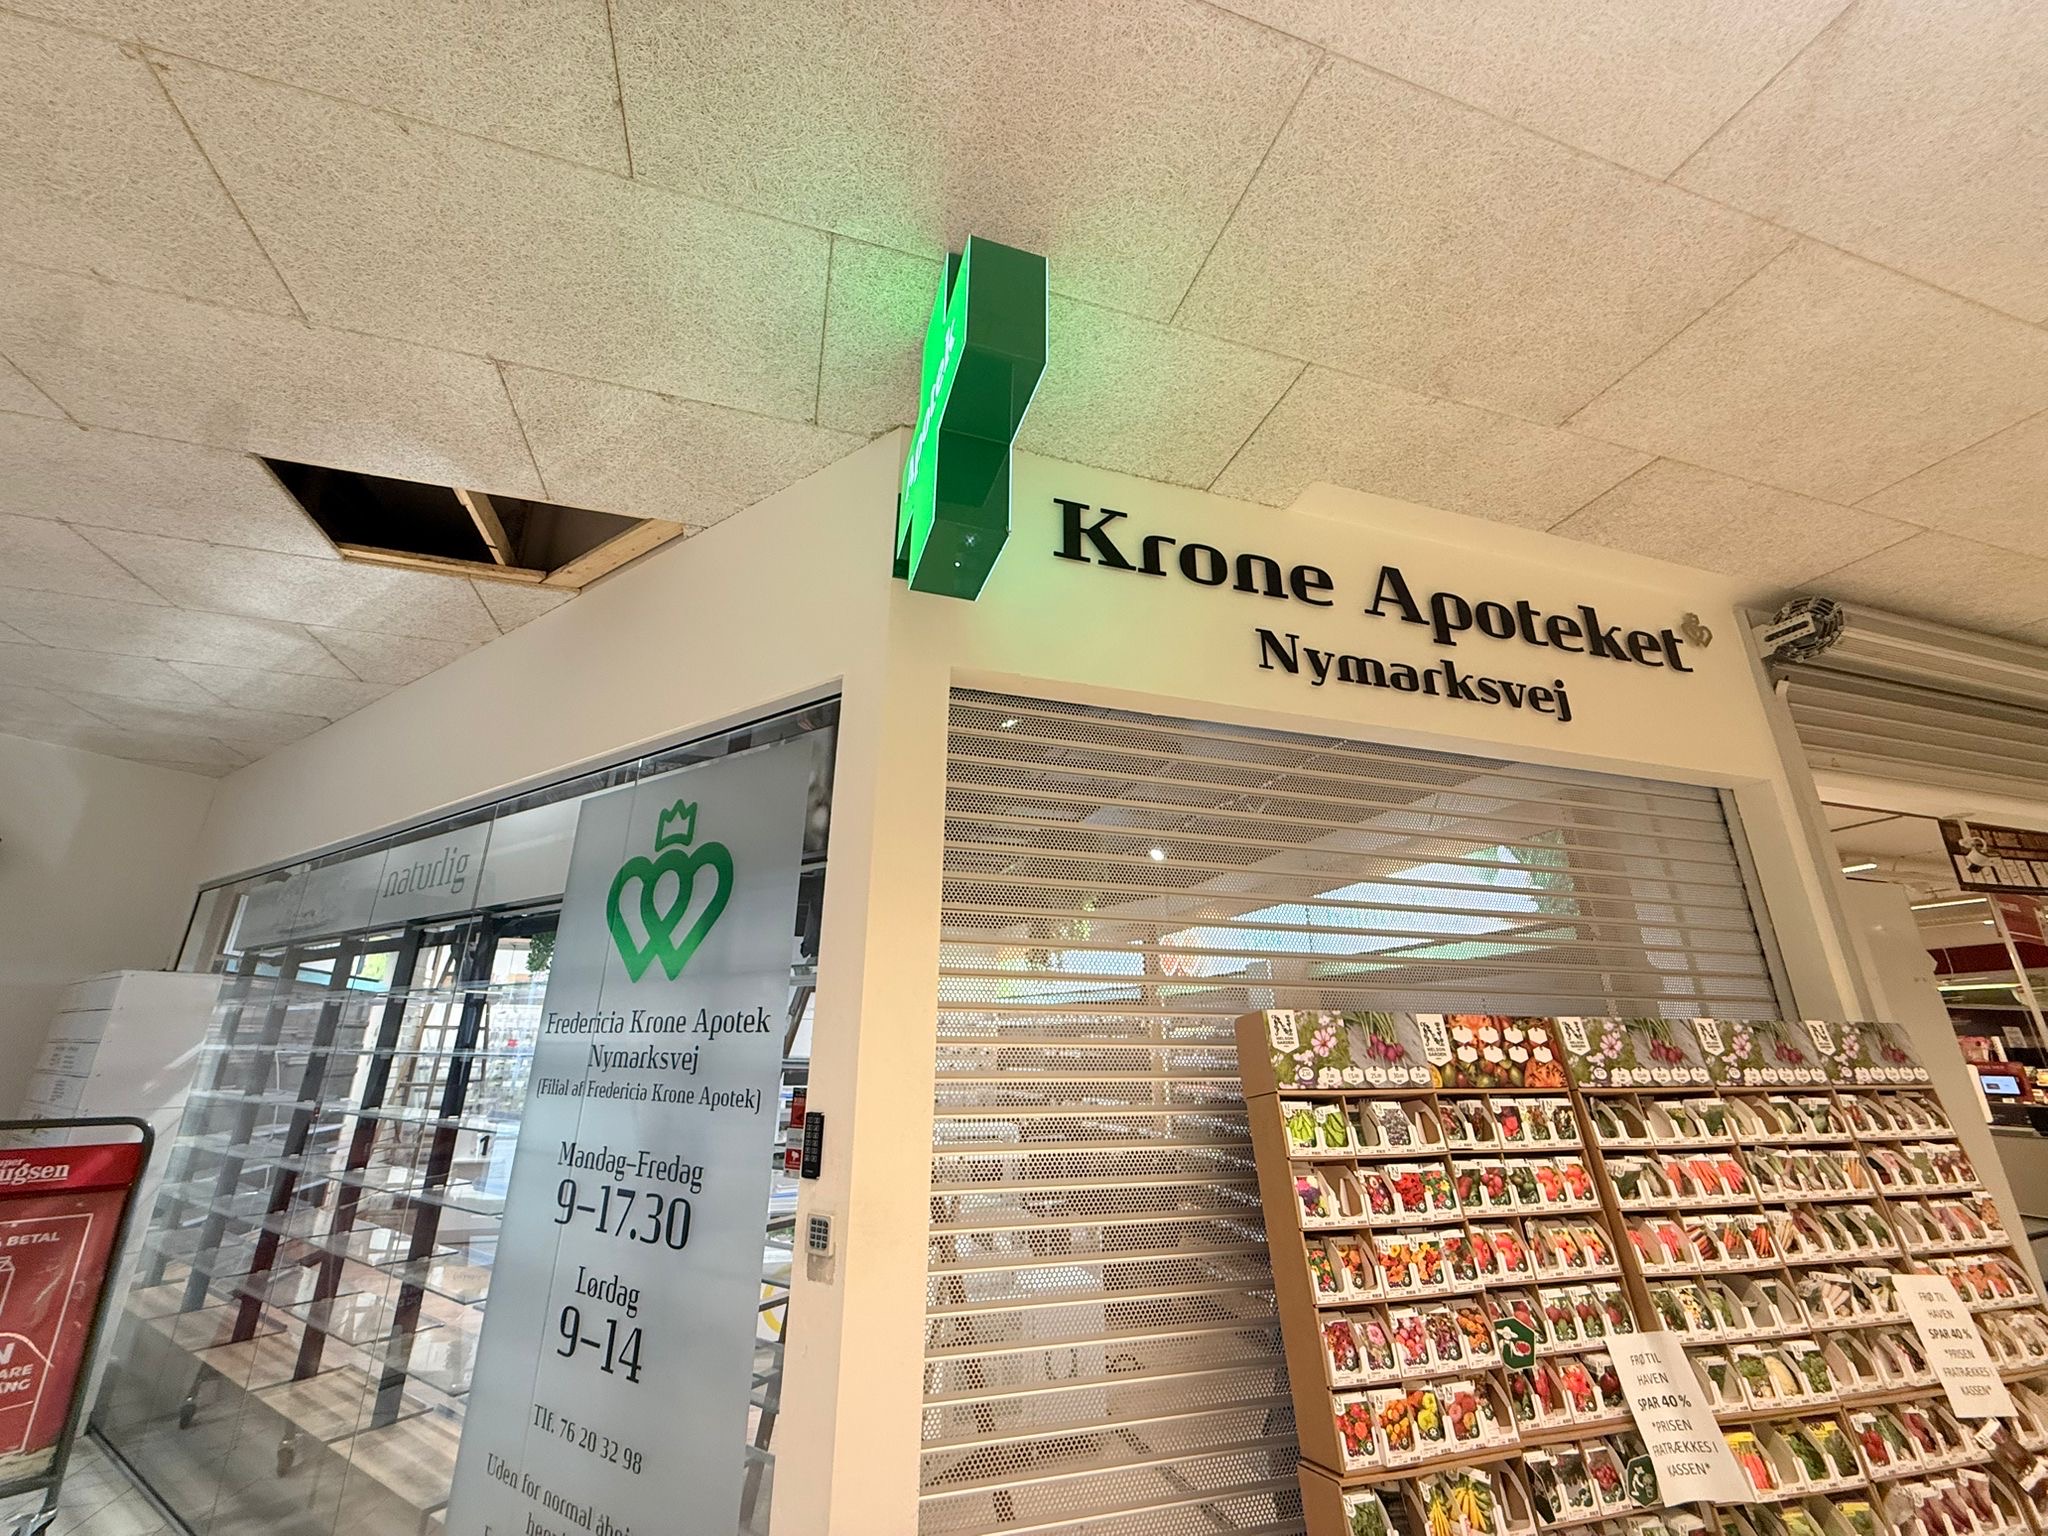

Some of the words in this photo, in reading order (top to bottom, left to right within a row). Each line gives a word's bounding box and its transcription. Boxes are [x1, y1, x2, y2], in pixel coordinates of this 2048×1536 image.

[1053, 497, 1334, 606] Krone
[1364, 565, 1694, 673] Apoteket
[1255, 627, 1573, 722] Nymarksvej
[382, 847, 471, 898] naturlig
[545, 1011, 624, 1034] Fredericia
[629, 1009, 687, 1034] Krone
[691, 1006, 771, 1041] Apotek
[588, 1044, 700, 1076] Nymarksvej
[537, 1078, 569, 1098] (Filial
[571, 1080, 585, 1097] af
[586, 1080, 647, 1101] Fredericia
[651, 1083, 695, 1104] Krone
[698, 1086, 761, 1114] Apotek)
[480, 1135, 490, 1156] 1
[6, 1231, 60, 1247] BETAL
[575, 1265, 640, 1318] Lørdag
[1927, 1309, 1955, 1319] HAVEN
[1928, 1328, 1950, 1339] SPAR
[1951, 1328, 1963, 1339] 40
[1630, 1353, 1645, 1366] FRØ
[1646, 1352, 1662, 1364] TIL
[1637, 1372, 1669, 1386] HAVEN
[1637, 1396, 1660, 1411] SPAR
[1661, 1395, 1678, 1408] 40
[534, 1403, 554, 1434] Tlf.
[560, 1418, 576, 1442] 76
[579, 1427, 597, 1452] 20
[600, 1437, 618, 1463] 32
[622, 1447, 642, 1474] 98
[1652, 1441, 1712, 1457] FRATRÆKKES
[487, 1453, 518, 1489] Uden
[521, 1473, 541, 1500] for
[542, 1489, 593, 1530] normal
